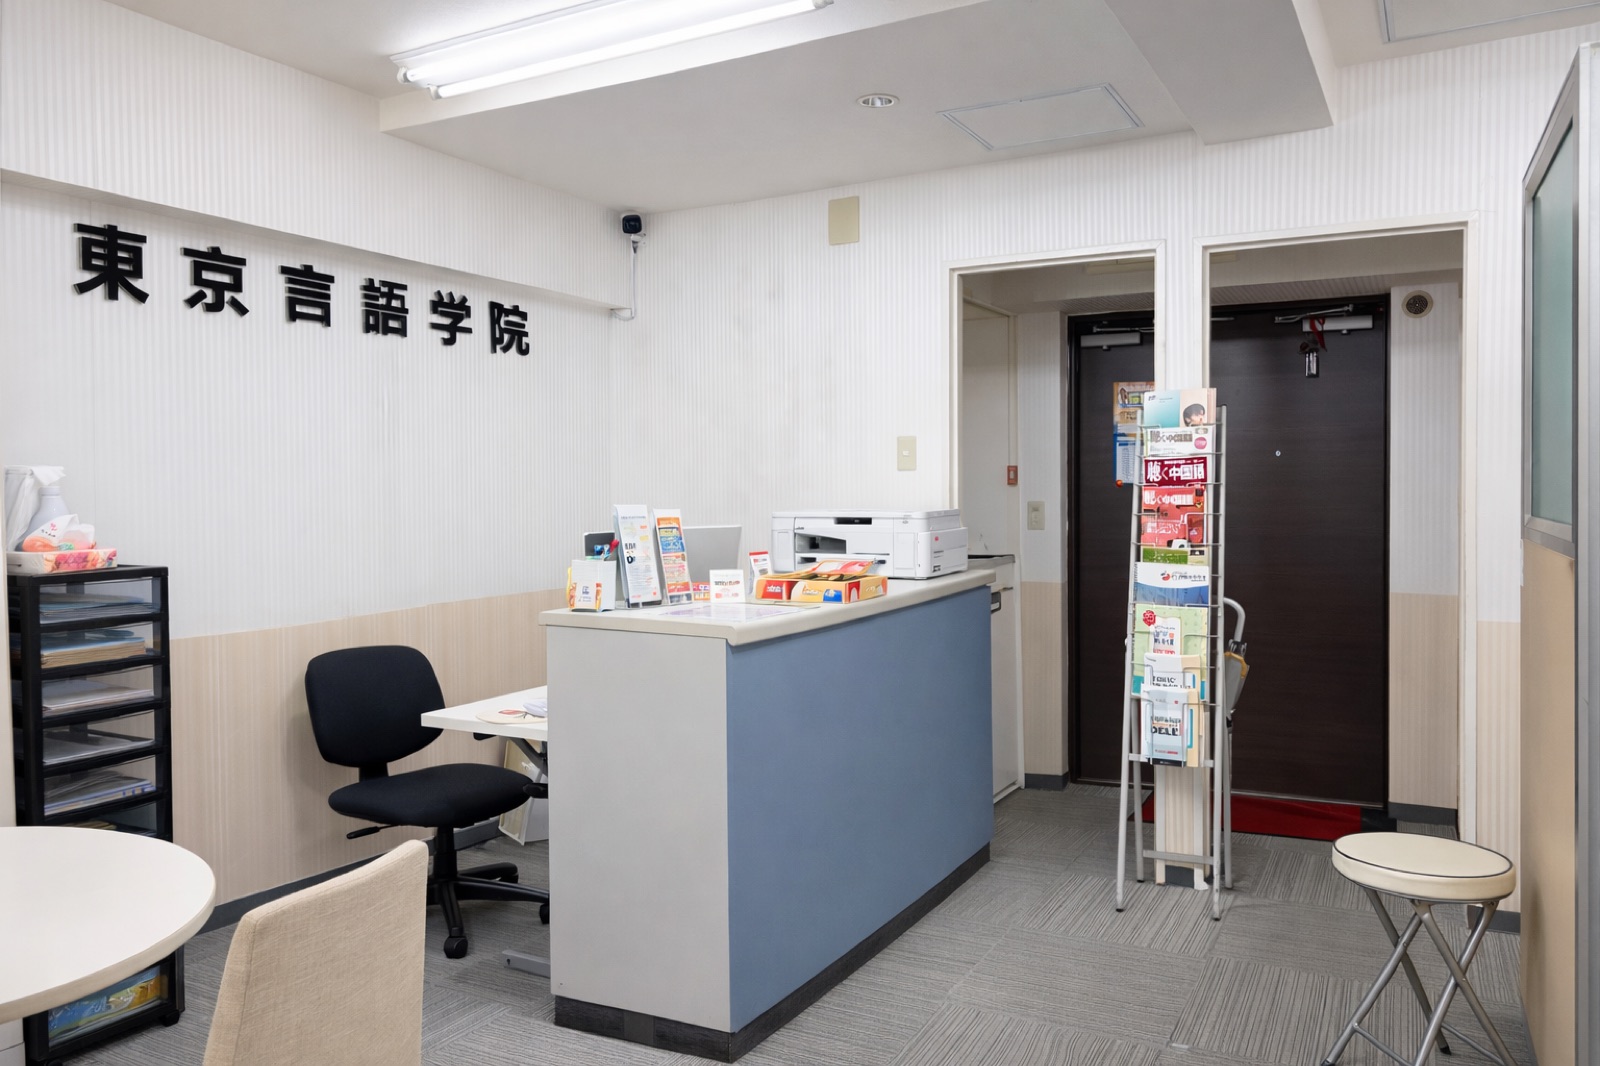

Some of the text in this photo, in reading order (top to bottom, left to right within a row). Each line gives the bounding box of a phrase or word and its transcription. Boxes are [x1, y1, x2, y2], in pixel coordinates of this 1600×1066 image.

[73, 223, 529, 356] 東京言語学院
